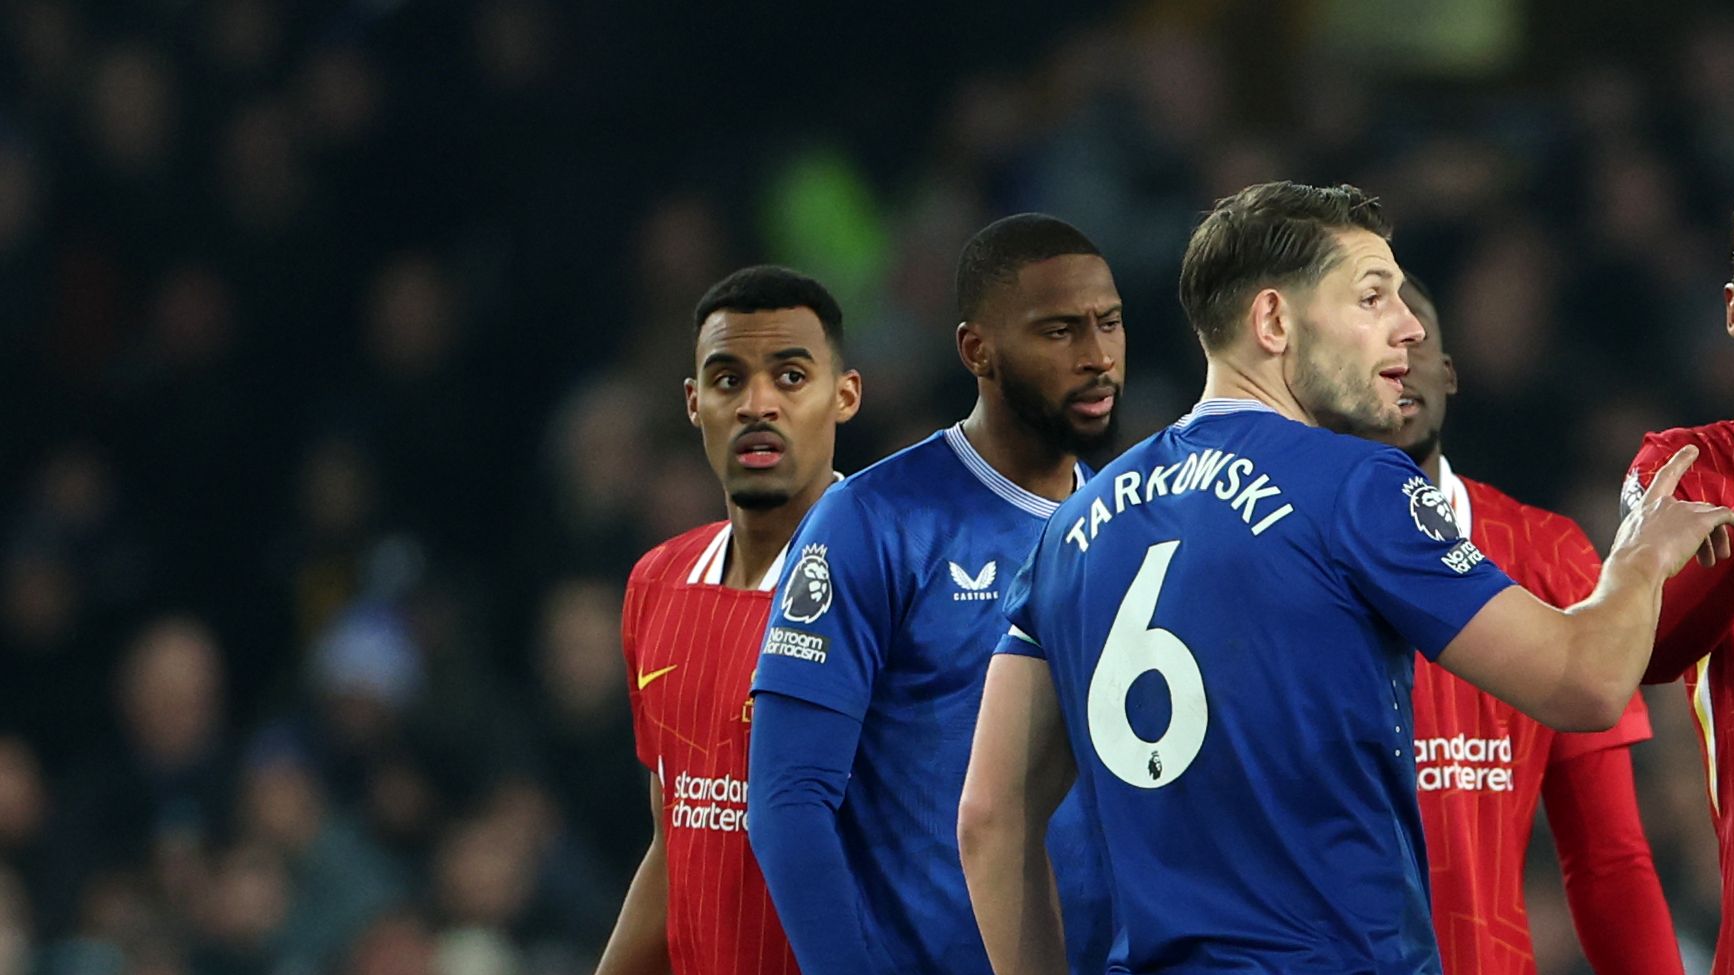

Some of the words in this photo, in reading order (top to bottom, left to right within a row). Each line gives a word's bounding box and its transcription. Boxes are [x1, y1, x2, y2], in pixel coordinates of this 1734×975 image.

[1065, 448, 1294, 553] TARKOWSKI
[1441, 550, 1464, 567] No
[953, 591, 999, 601] CASTORE
[769, 627, 784, 642] No
[784, 631, 823, 650] room
[780, 642, 827, 664] racism
[1087, 539, 1209, 790] 6
[1414, 732, 1512, 762] andard
[674, 770, 749, 803] standar
[1417, 760, 1514, 791] artere
[672, 799, 749, 832] charter
